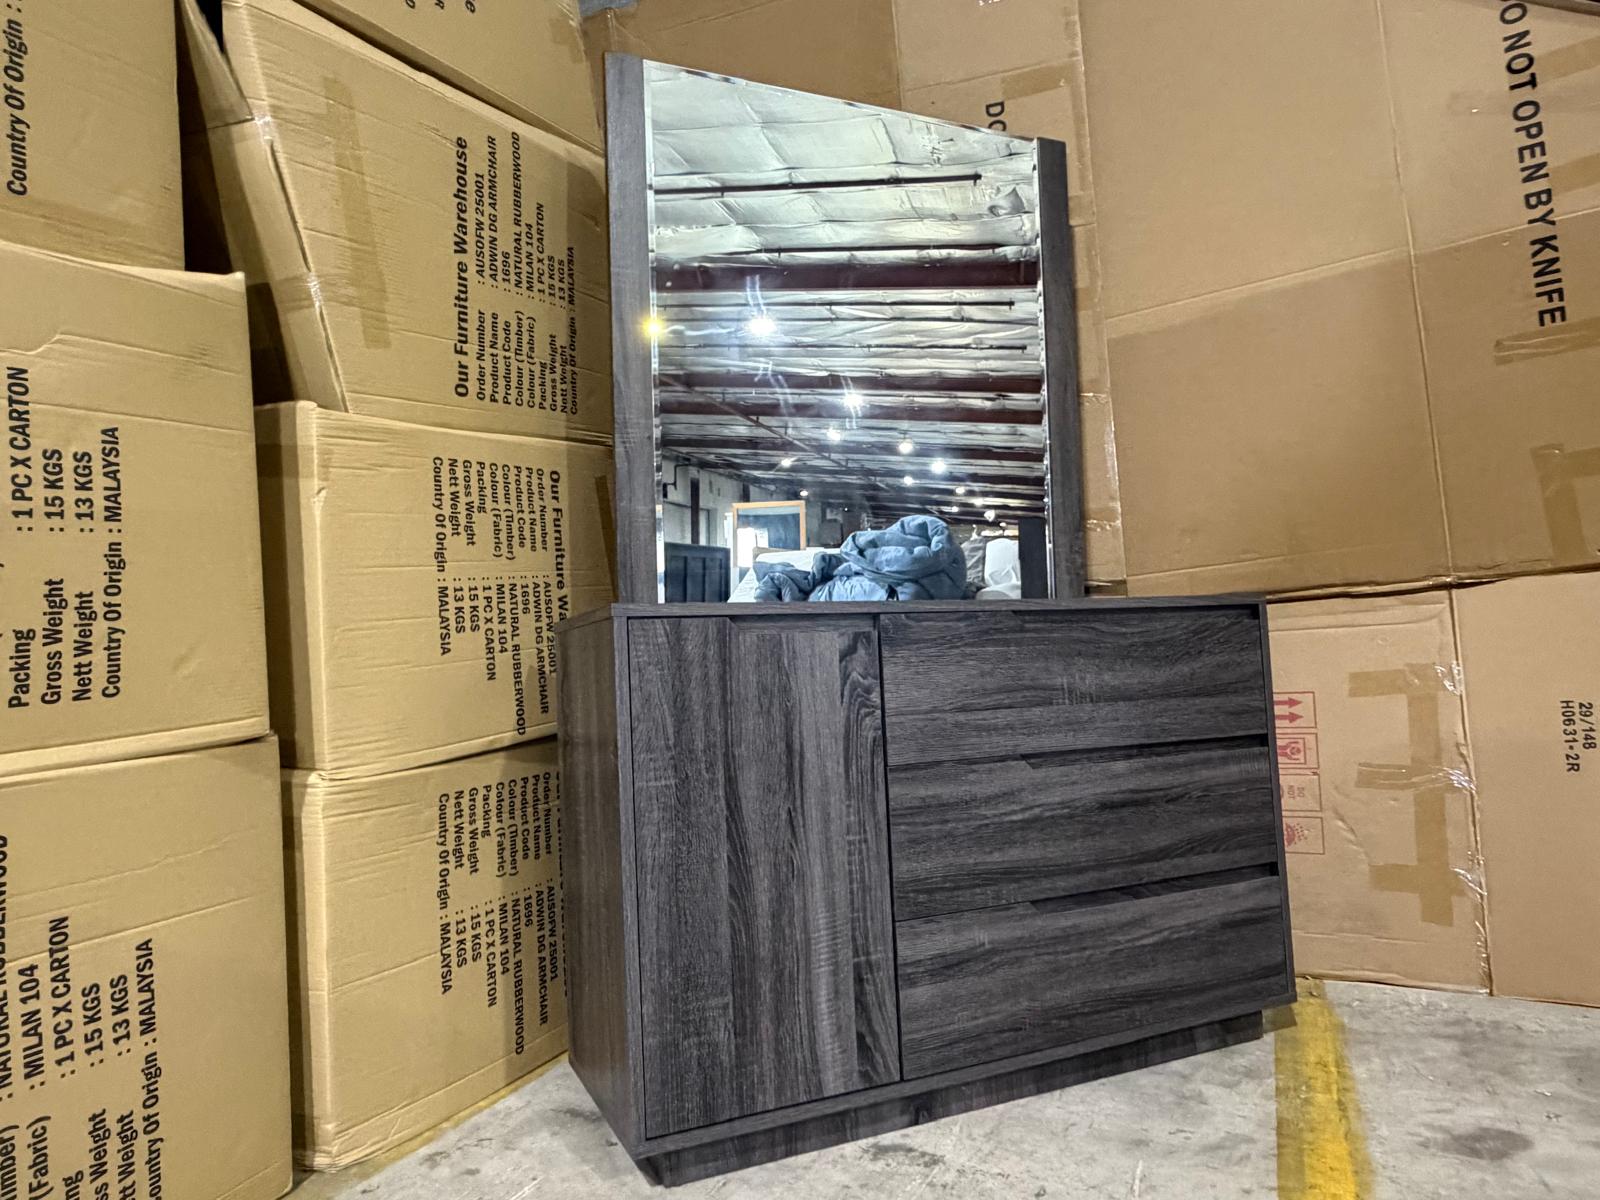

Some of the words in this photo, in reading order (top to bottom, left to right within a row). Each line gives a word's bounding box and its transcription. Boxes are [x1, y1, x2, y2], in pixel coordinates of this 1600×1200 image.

[1500, 0, 1527, 24] O
[3, 18, 28, 82] Origin
[1502, 30, 1538, 91] NOT
[3, 83, 25, 110] Of
[6, 114, 30, 196] Country
[1512, 100, 1550, 183] OPEN
[475, 173, 484, 217] 25001
[488, 136, 498, 211] ARMCHAIR
[512, 132, 522, 226] RUBBERWOOD
[453, 137, 468, 254] Warehouse
[1524, 188, 1556, 226] BY
[489, 214, 498, 232] DG
[525, 223, 533, 248] 104
[536, 202, 544, 254] CARTON
[475, 218, 485, 278] AUSOFW
[489, 236, 498, 282] ADWIN
[502, 251, 510, 283] 1696
[514, 231, 522, 288] NATURAL
[548, 256, 556, 280] KGS
[526, 251, 534, 292] MILAN
[537, 266, 545, 285] PC
[1529, 234, 1566, 327] KNIFE
[454, 261, 468, 356] Furniture
[476, 309, 485, 361] Number
[490, 312, 498, 350] Name
[502, 320, 511, 352] Code
[514, 310, 525, 363] (Timber)
[526, 316, 536, 365] (Fabric)
[454, 361, 469, 397] Our
[476, 364, 486, 400] Order
[490, 353, 498, 403] Product
[503, 356, 512, 405] Product
[515, 366, 524, 406] Colour
[527, 368, 536, 408] Colour
[538, 361, 548, 410] Packing
[550, 378, 558, 411] Gross
[6, 366, 31, 450] CARTON
[10, 456, 32, 469] X
[42, 449, 64, 490] KGS
[72, 451, 94, 491] KGS
[100, 427, 122, 522] MALAYSIA
[432, 456, 445, 510] Country
[448, 458, 459, 488] Nett
[462, 460, 472, 498] Gross
[11, 474, 33, 501] PC
[476, 461, 487, 514] Packing
[490, 462, 499, 507] Colour
[502, 464, 511, 507] Colour
[514, 465, 524, 514] Product
[526, 467, 536, 514] Product
[536, 468, 545, 504] Order
[550, 470, 560, 502] Our
[12, 508, 33, 519] 1
[44, 496, 64, 520] 15
[74, 498, 94, 520] 13
[435, 514, 446, 528] Of
[449, 490, 462, 537] Weight
[464, 500, 476, 546] Weight
[539, 505, 548, 552] Number
[434, 532, 447, 572] Origin
[490, 508, 503, 558] (Fabric)
[504, 508, 516, 560] (Timber)
[517, 516, 526, 548] Code
[529, 518, 537, 552] Name
[553, 508, 566, 590] Furniture
[104, 542, 126, 596] Origin
[42, 578, 68, 646] Weight
[103, 602, 122, 621] Of
[454, 586, 464, 602] 13
[468, 585, 478, 602] 15
[483, 596, 492, 614] PC
[496, 583, 506, 624] MILAN
[509, 583, 520, 641] NATURAL
[521, 583, 530, 614] 1696
[532, 582, 542, 622] ADWIN
[543, 582, 555, 634] AUSOFW
[74, 591, 98, 658] Weight
[438, 586, 452, 656] MALAYSIA
[454, 606, 466, 634] KGS
[469, 605, 480, 632] KGS
[534, 626, 544, 644] DG
[102, 627, 126, 698] Country
[484, 628, 496, 680] CARTON
[498, 630, 508, 654] 104
[8, 628, 36, 708] Packing
[40, 650, 62, 704] Gross
[72, 661, 92, 702] Nett
[512, 644, 526, 735] RUBBERWOOD
[536, 648, 549, 714] ARMCHAIR
[1578, 702, 1597, 750] 29/148
[436, 793, 450, 846] Country
[454, 790, 464, 820] Nett
[468, 787, 478, 826] Gross
[481, 785, 492, 838] Packing
[496, 782, 504, 824] Colour
[520, 777, 529, 826] Product
[438, 850, 450, 866] Of
[452, 822, 464, 870] Weight
[467, 828, 479, 875] Weight
[494, 826, 506, 878] (Fabric)
[508, 824, 519, 876] (Timber)
[437, 868, 450, 910] Origin
[456, 918, 466, 936] 13
[471, 914, 480, 930] 15
[485, 909, 494, 917] 1
[486, 919, 494, 938] PC
[500, 902, 508, 945] MILAN
[512, 898, 522, 958] NATURAL
[536, 890, 546, 932] ADWIN
[48, 916, 71, 998] CARTON
[440, 922, 452, 995] MALAYSIA
[456, 938, 467, 968] KGS
[471, 934, 482, 962] KGS
[486, 940, 496, 950] X
[501, 949, 510, 975] 104
[538, 934, 546, 953] DG
[549, 941, 558, 980] 25001
[18, 964, 40, 1004] 104
[110, 974, 129, 1016] KGS
[136, 938, 156, 1036] MALAYSIA
[486, 952, 497, 1008] CARTON
[538, 955, 549, 1026] ARMCHAIR
[52, 1000, 72, 1018] X
[82, 982, 102, 1026] KGS
[514, 960, 524, 1055] RUBBERWOOD
[20, 1008, 44, 1080] MILAN
[53, 1019, 74, 1050] PC
[84, 1028, 104, 1056] 15
[112, 1018, 130, 1046] 13
[56, 1051, 75, 1066] 1
[141, 1052, 162, 1109] Origin
[143, 1112, 160, 1135] Of
[88, 1108, 111, 1184] Weight
[116, 1110, 138, 1184] Weight
[144, 1137, 164, 1200] ountry
